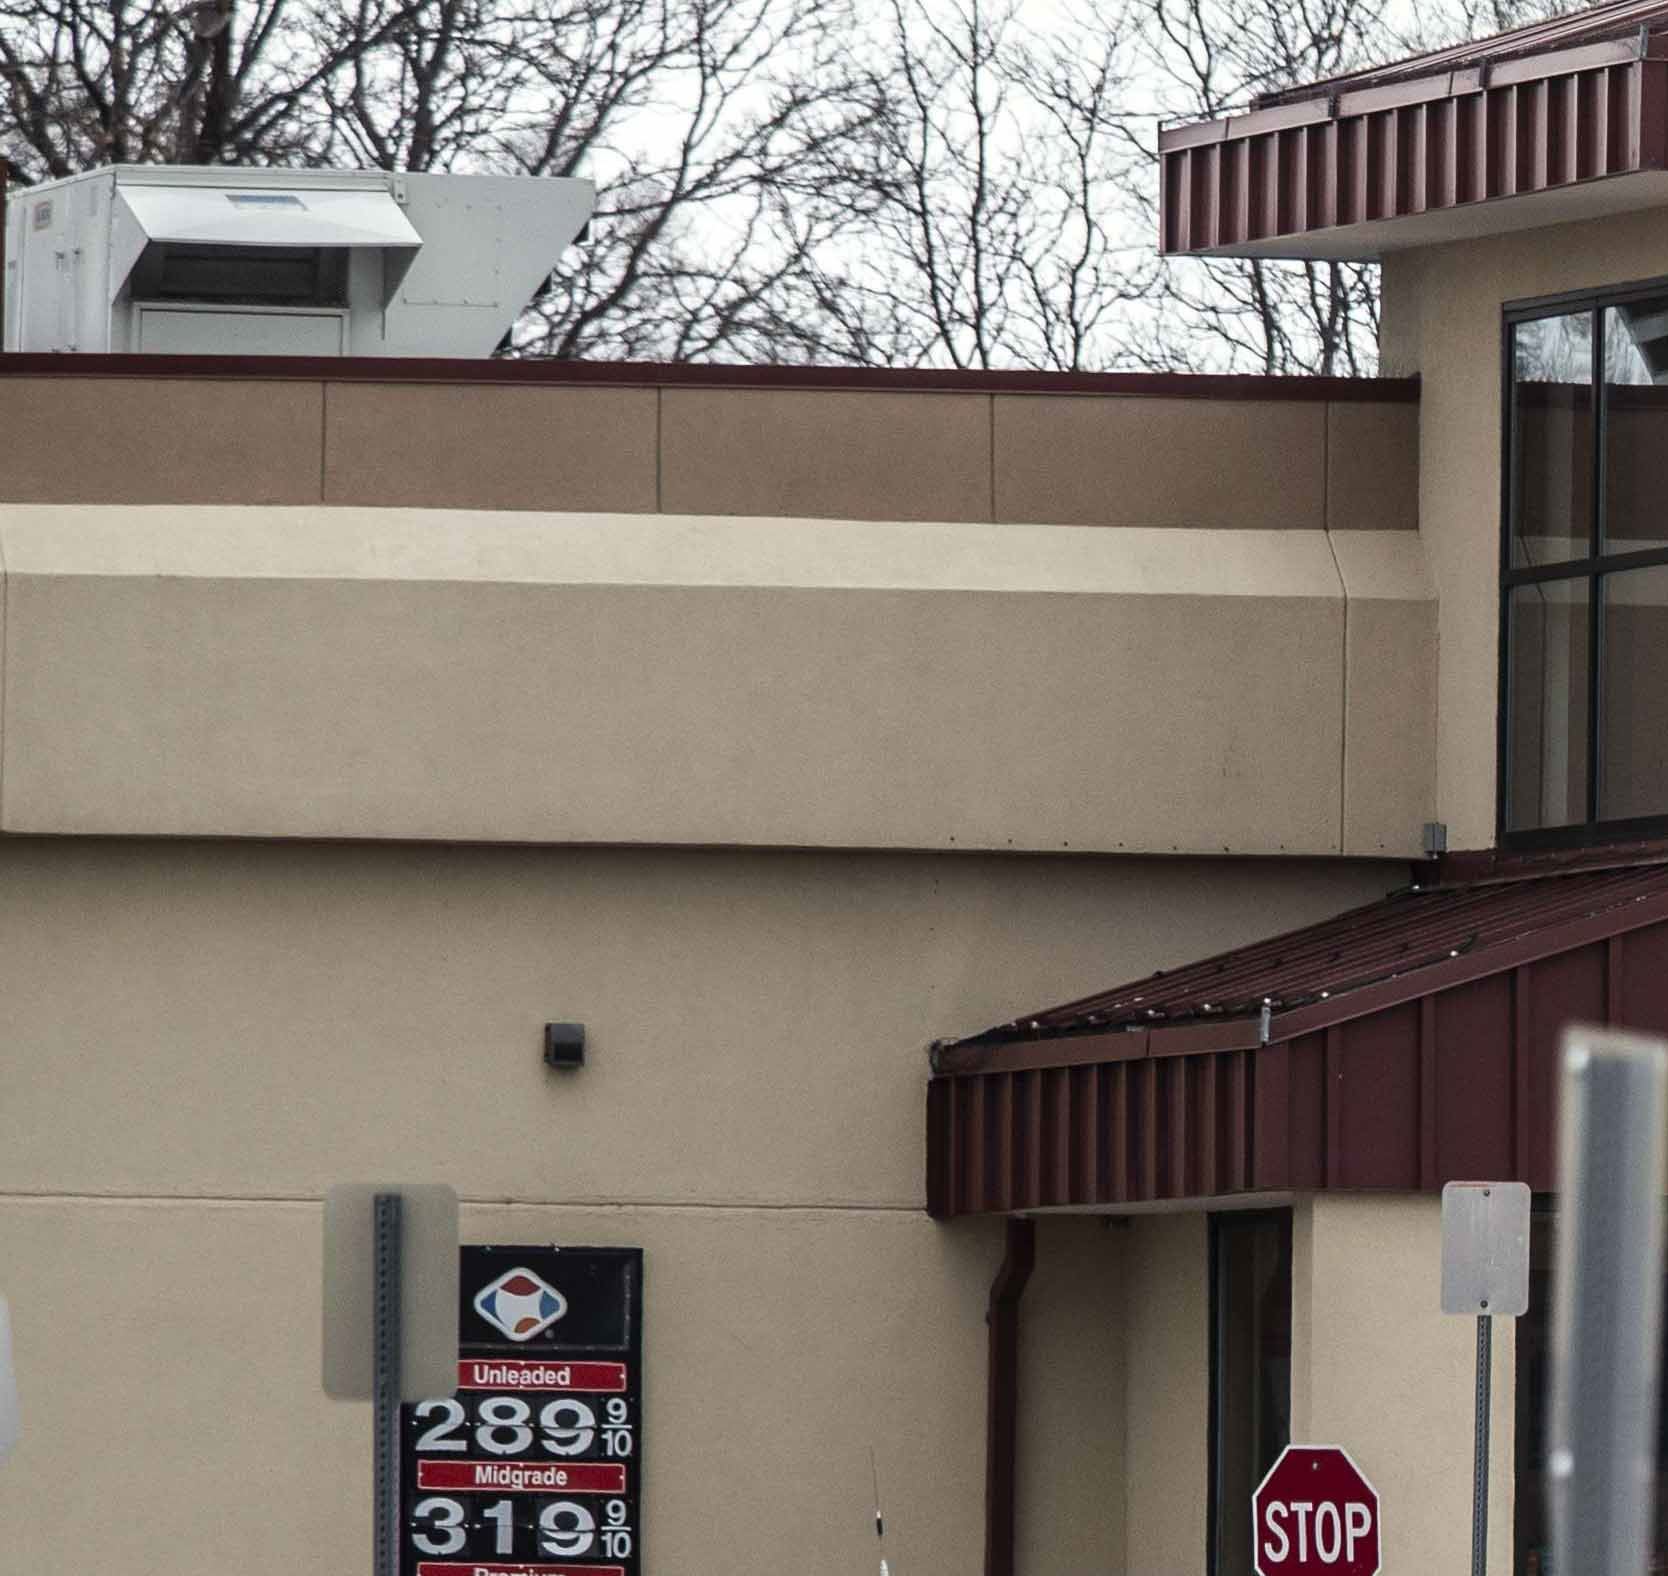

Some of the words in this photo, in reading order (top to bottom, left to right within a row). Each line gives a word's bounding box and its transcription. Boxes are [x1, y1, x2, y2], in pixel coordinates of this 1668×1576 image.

[473, 1365, 571, 1386] Unleaded
[415, 1397, 596, 1456] 289
[475, 1466, 568, 1488] Midgrade
[411, 1498, 596, 1556] 319
[1264, 1501, 1372, 1563] STOP
